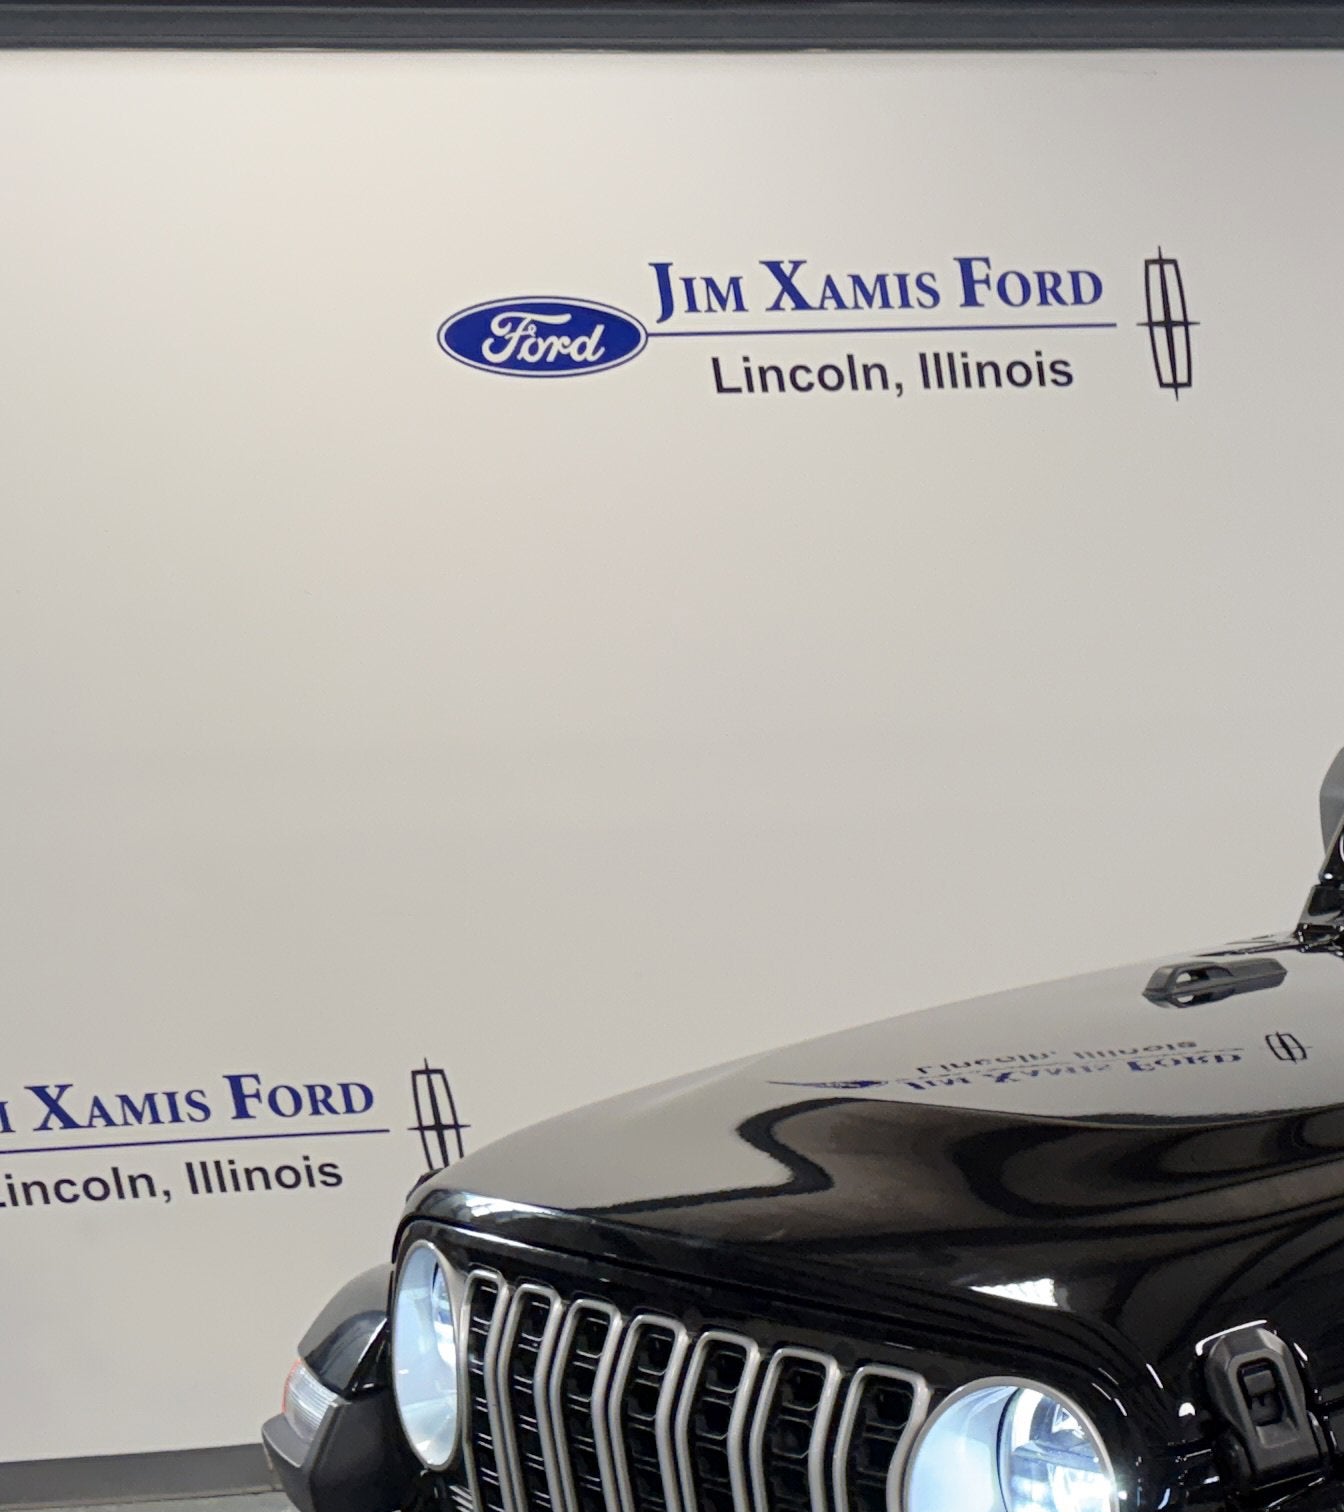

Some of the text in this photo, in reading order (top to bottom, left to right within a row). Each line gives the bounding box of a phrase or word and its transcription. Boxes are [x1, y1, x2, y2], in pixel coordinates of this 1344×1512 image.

[759, 260, 941, 312] XAMIS
[953, 256, 1103, 308] FORD
[481, 311, 605, 364] Ford
[711, 350, 1074, 398] Lincoln, Illinois
[24, 1083, 212, 1132] XAMIS
[222, 1073, 374, 1120] FORD
[0, 1155, 343, 1208] incoln, Illinois
